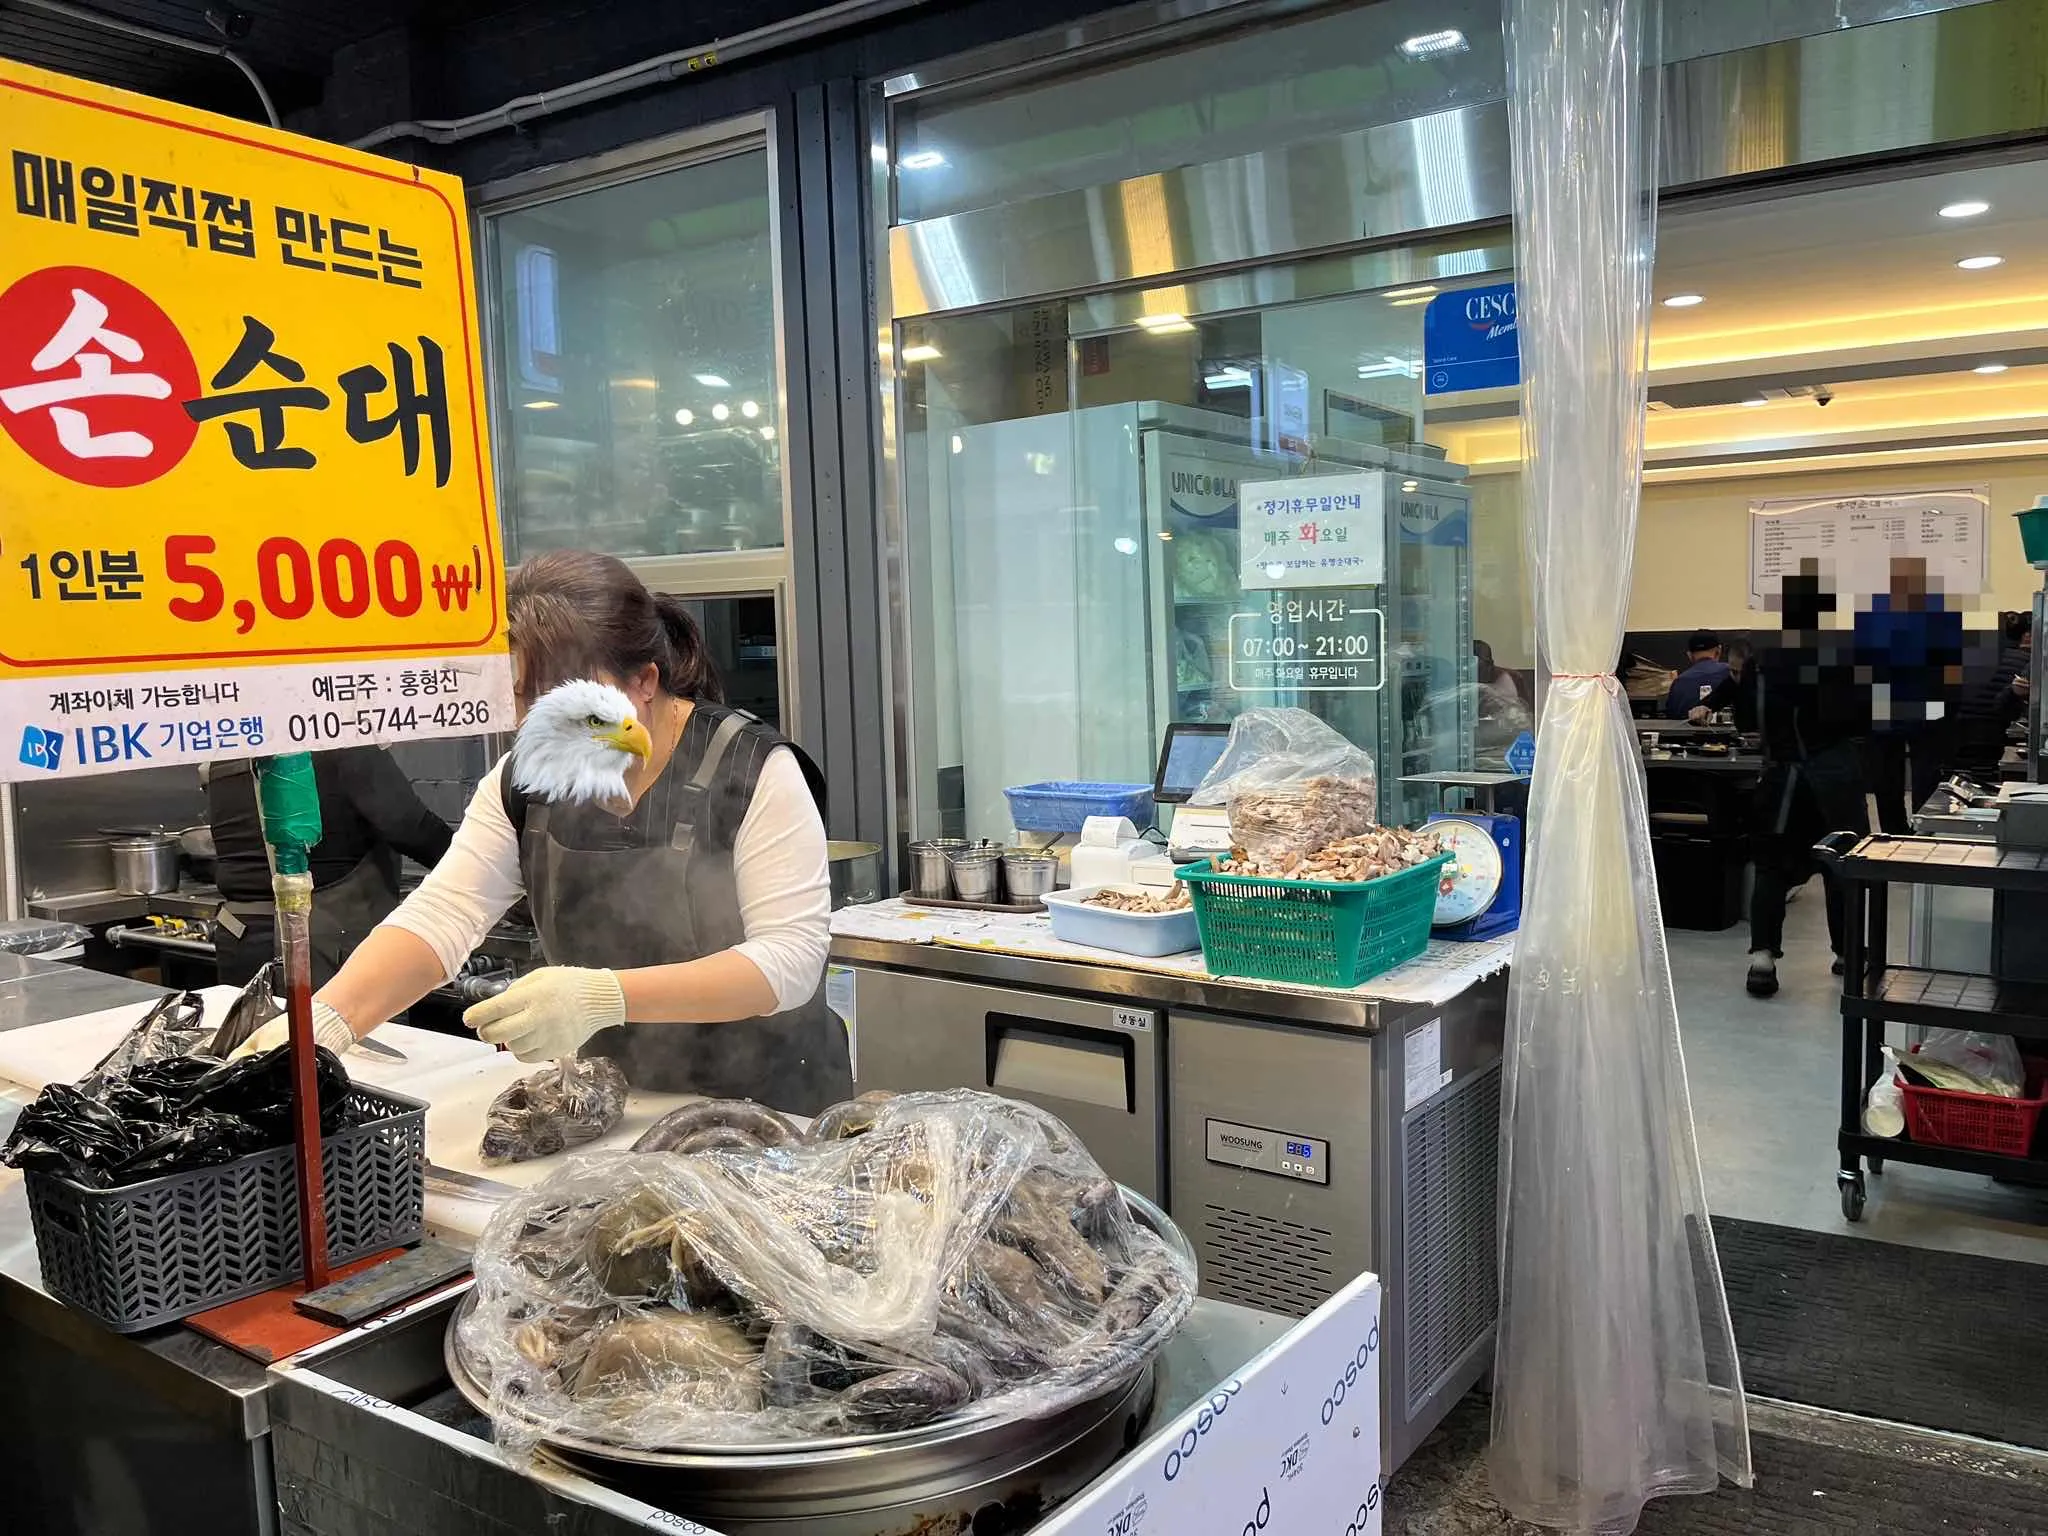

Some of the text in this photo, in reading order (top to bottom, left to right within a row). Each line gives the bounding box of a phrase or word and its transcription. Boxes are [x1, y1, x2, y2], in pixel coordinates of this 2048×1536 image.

[12, 149, 423, 289] 매일직접 만드는
[0, 288, 453, 488] 손순대
[1263, 494, 1361, 515] 정기휴무일안내
[1264, 522, 1348, 546] 매주 화요일
[20, 550, 144, 601] 1인분
[1266, 599, 1346, 624] 영업시간
[1315, 635, 1369, 656] 21:00
[312, 671, 378, 703] 예금주
[399, 667, 459, 697] 홍형진
[1308, 666, 1359, 680] 휴무입니다
[49, 681, 240, 715] 계좌이체 가능합니다
[289, 702, 490, 744] 010-5744-4236
[75, 715, 265, 765] IBK 기업은행
[1118, 1013, 1146, 1028] 냉동실
[1220, 1134, 1263, 1149] WOOSUNG
[1322, 1316, 1379, 1425] posco
[646, 1510, 706, 1536] posco
